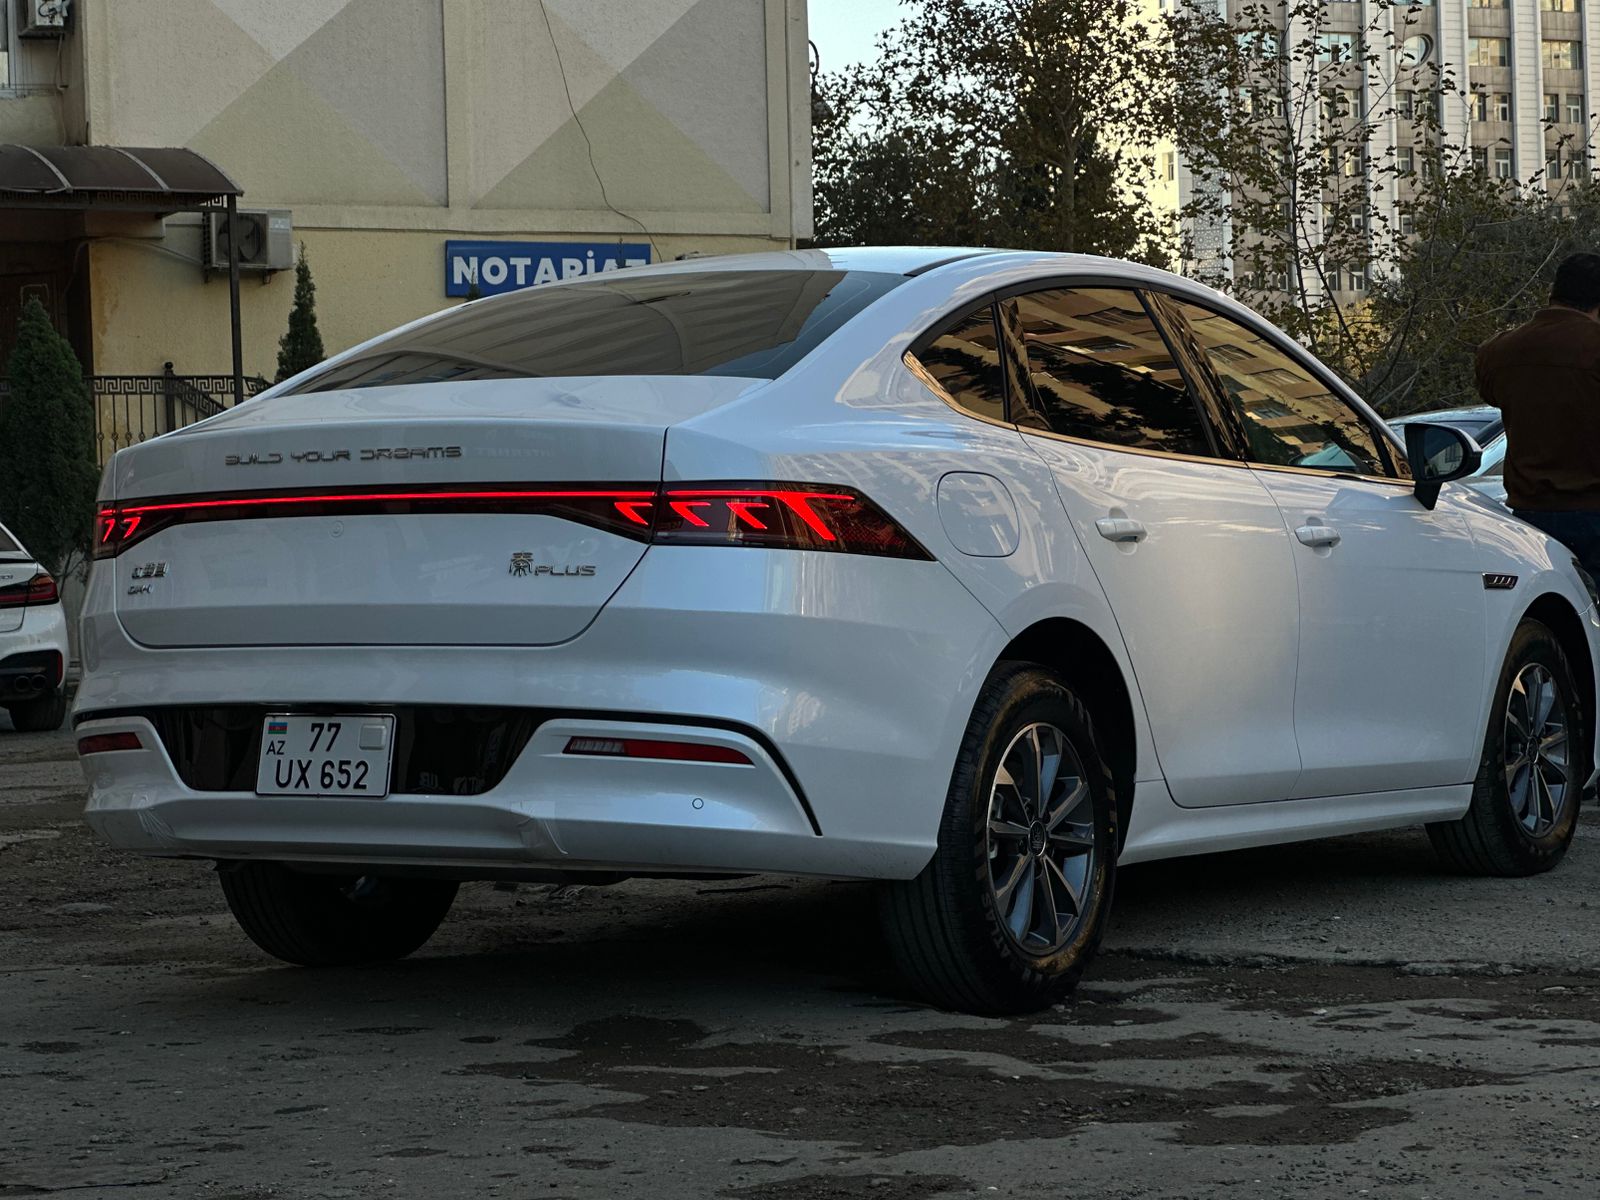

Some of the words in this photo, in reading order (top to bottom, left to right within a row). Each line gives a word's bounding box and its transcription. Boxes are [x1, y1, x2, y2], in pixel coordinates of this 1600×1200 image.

[453, 250, 646, 285] NOTARİ
[225, 454, 283, 466] BUILD
[290, 450, 351, 463] YOUR
[360, 446, 462, 460] DREAMS
[534, 565, 596, 576] PLUS
[266, 740, 286, 756] AZ
[309, 722, 341, 752] 77
[275, 759, 313, 789] UX
[320, 760, 369, 790] 652
